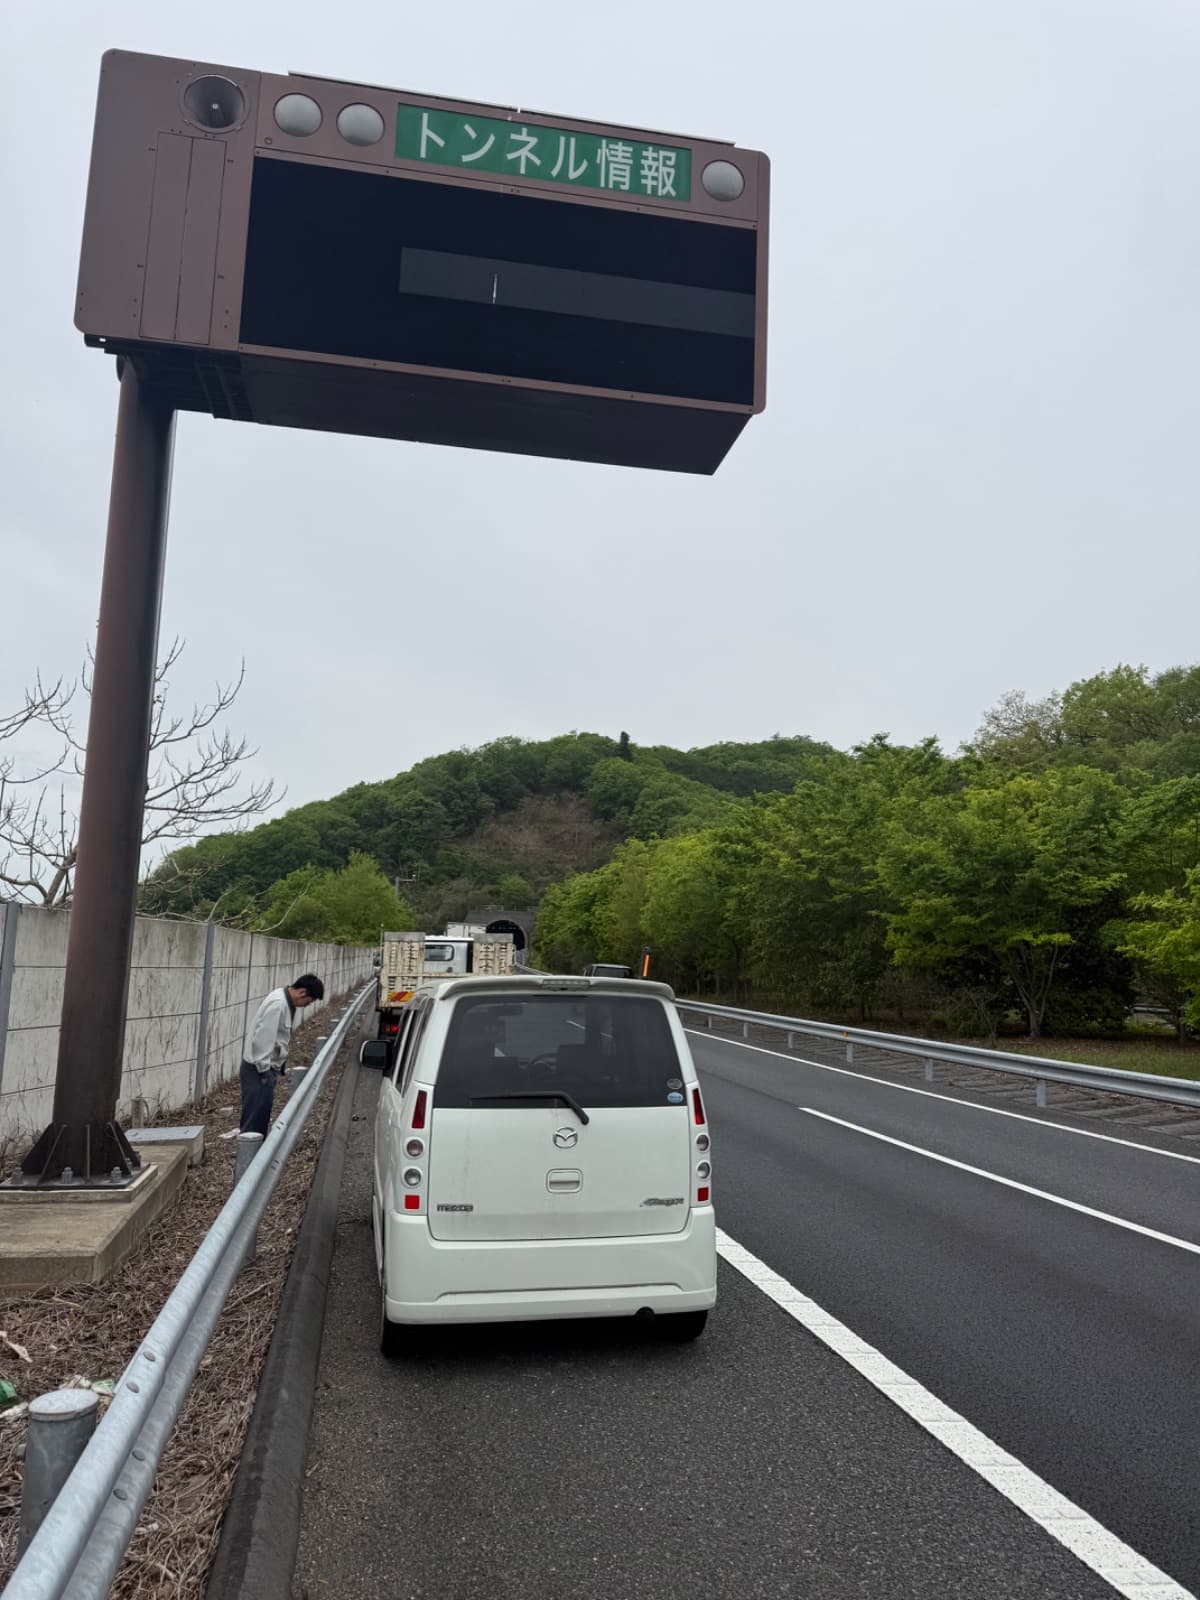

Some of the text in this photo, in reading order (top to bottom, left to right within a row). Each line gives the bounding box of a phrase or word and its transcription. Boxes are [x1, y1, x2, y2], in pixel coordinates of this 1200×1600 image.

[419, 112, 677, 197] トンネル情報
